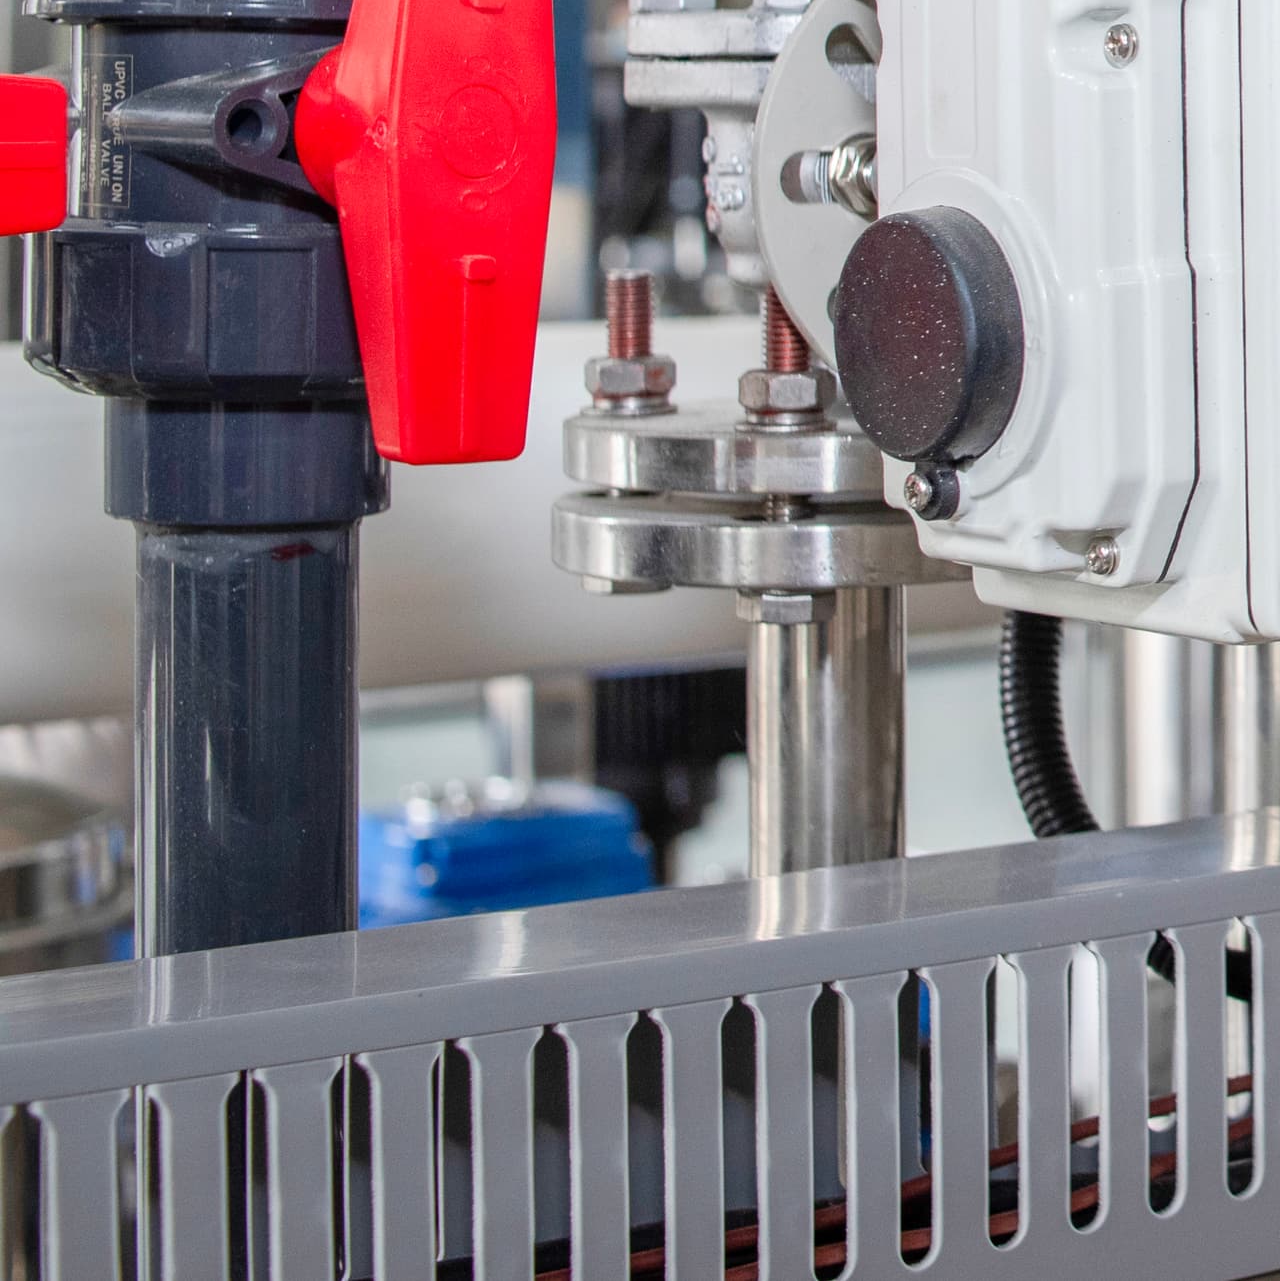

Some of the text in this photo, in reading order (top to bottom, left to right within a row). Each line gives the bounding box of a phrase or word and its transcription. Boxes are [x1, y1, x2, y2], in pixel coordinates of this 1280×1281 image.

[114, 61, 125, 99] UPVC
[101, 83, 112, 187] BALL VALVE
[112, 155, 124, 203] UNION
